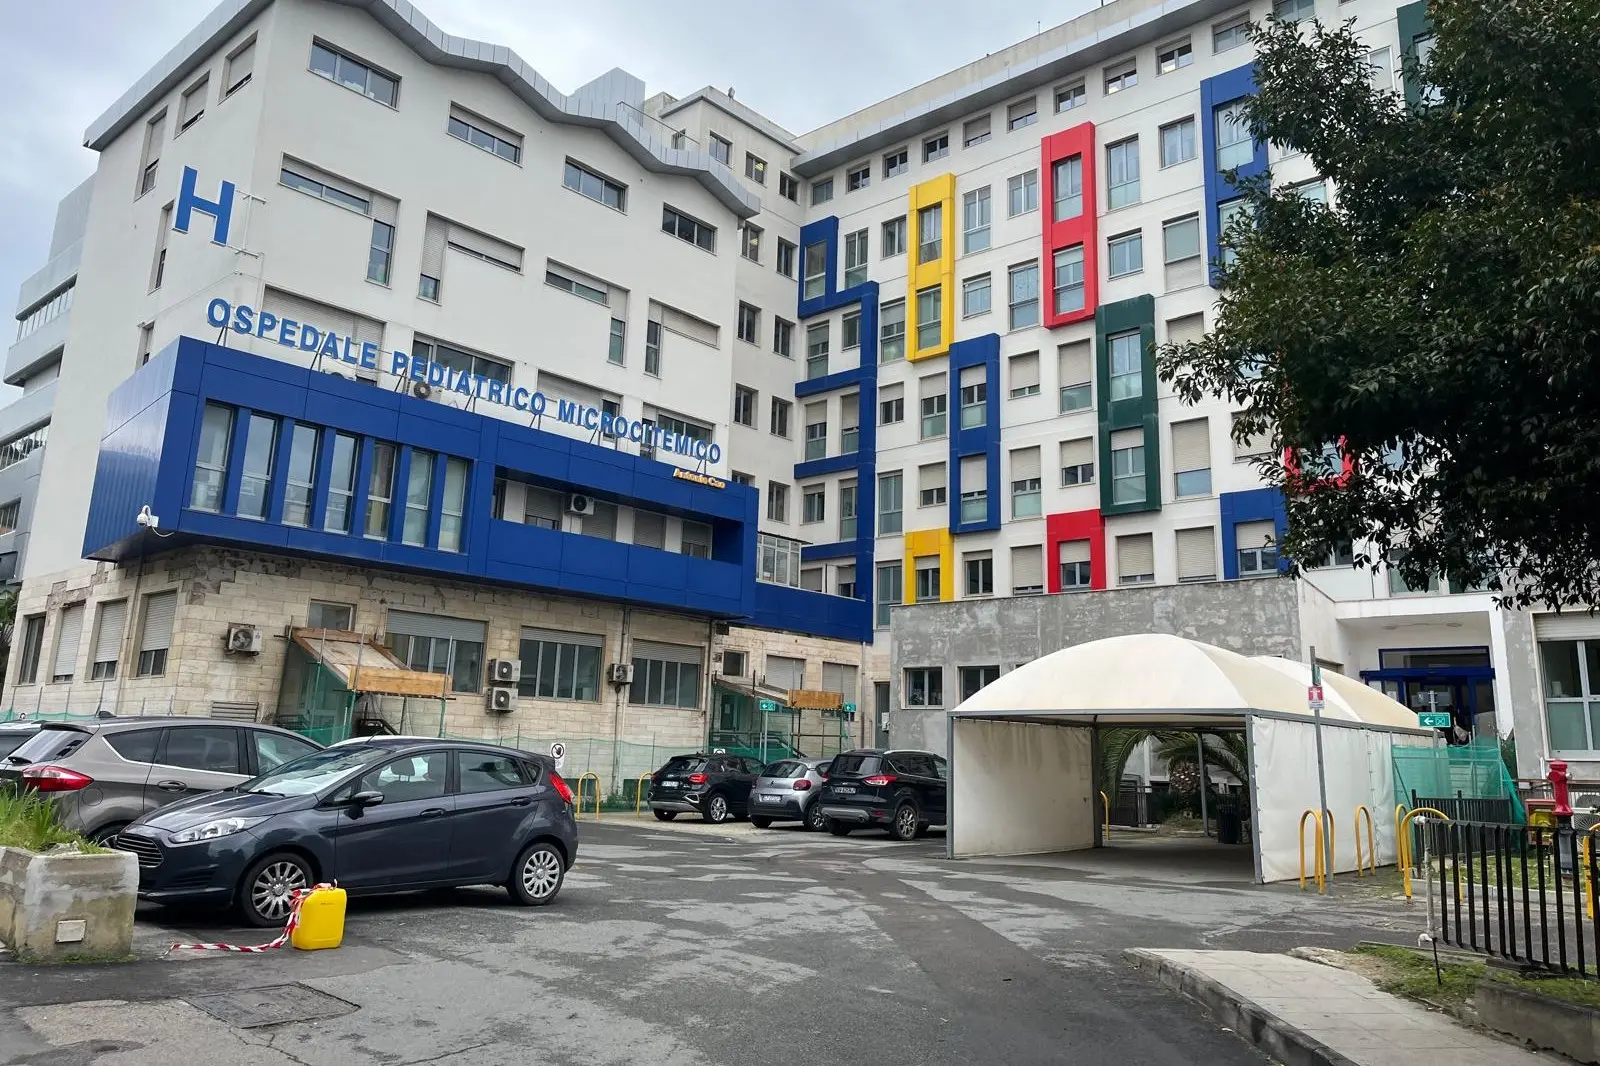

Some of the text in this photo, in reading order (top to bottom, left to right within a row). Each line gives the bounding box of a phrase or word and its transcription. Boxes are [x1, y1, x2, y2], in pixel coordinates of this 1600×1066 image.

[172, 165, 236, 246] H
[206, 298, 722, 465] OSPEDALE PEDIATRICO MICROCITEMICO
